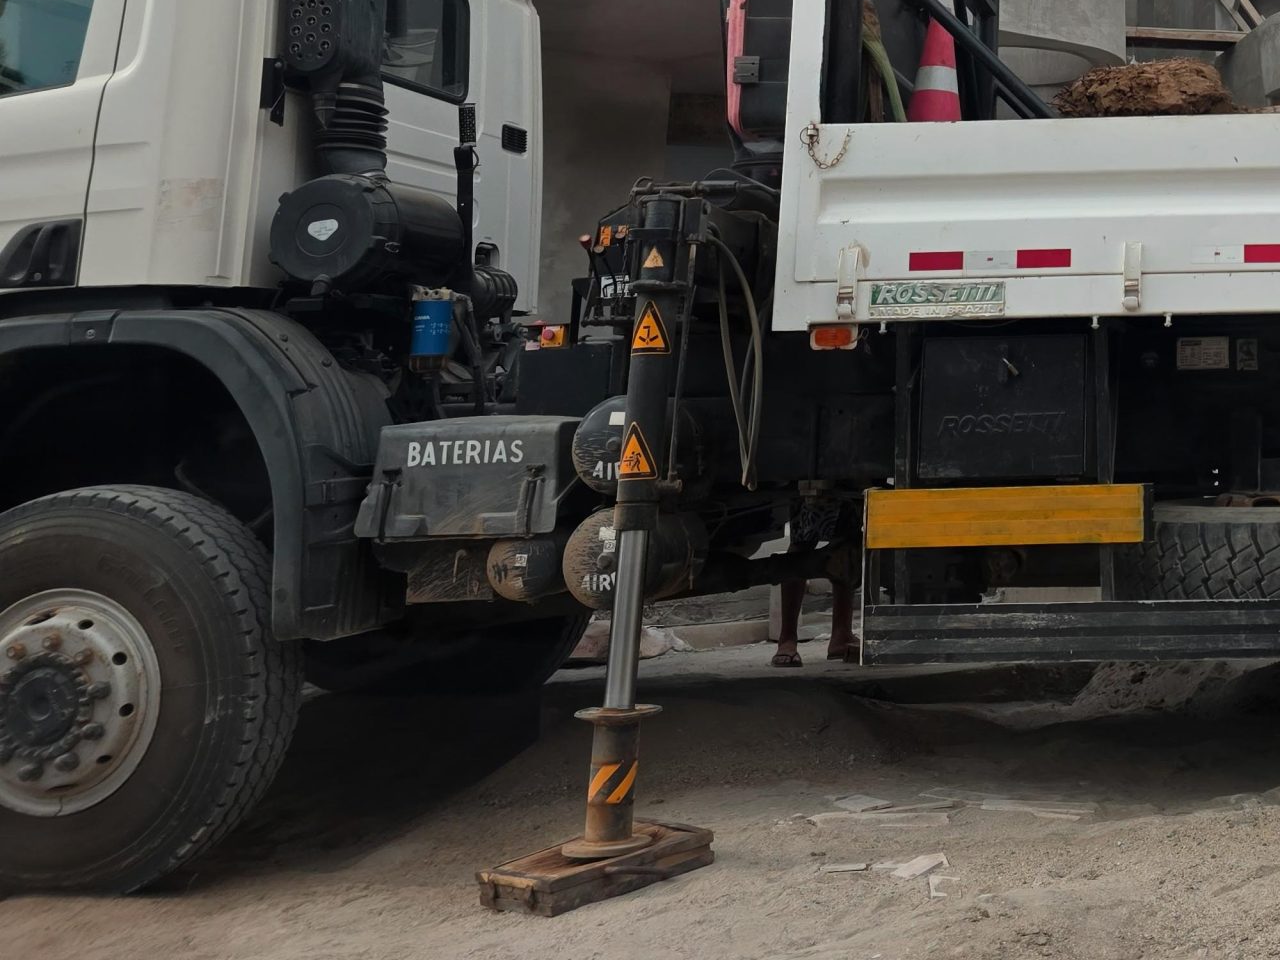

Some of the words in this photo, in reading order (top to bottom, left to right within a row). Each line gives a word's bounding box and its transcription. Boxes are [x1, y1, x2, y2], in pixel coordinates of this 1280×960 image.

[876, 283, 999, 304] ROSSETTI
[878, 306, 920, 317] MADE
[926, 306, 941, 316] IN
[946, 304, 998, 316] BRAZIL
[937, 411, 1068, 439] ROSSETTI
[407, 439, 524, 468] BATERIAS
[580, 572, 617, 592] AIR
